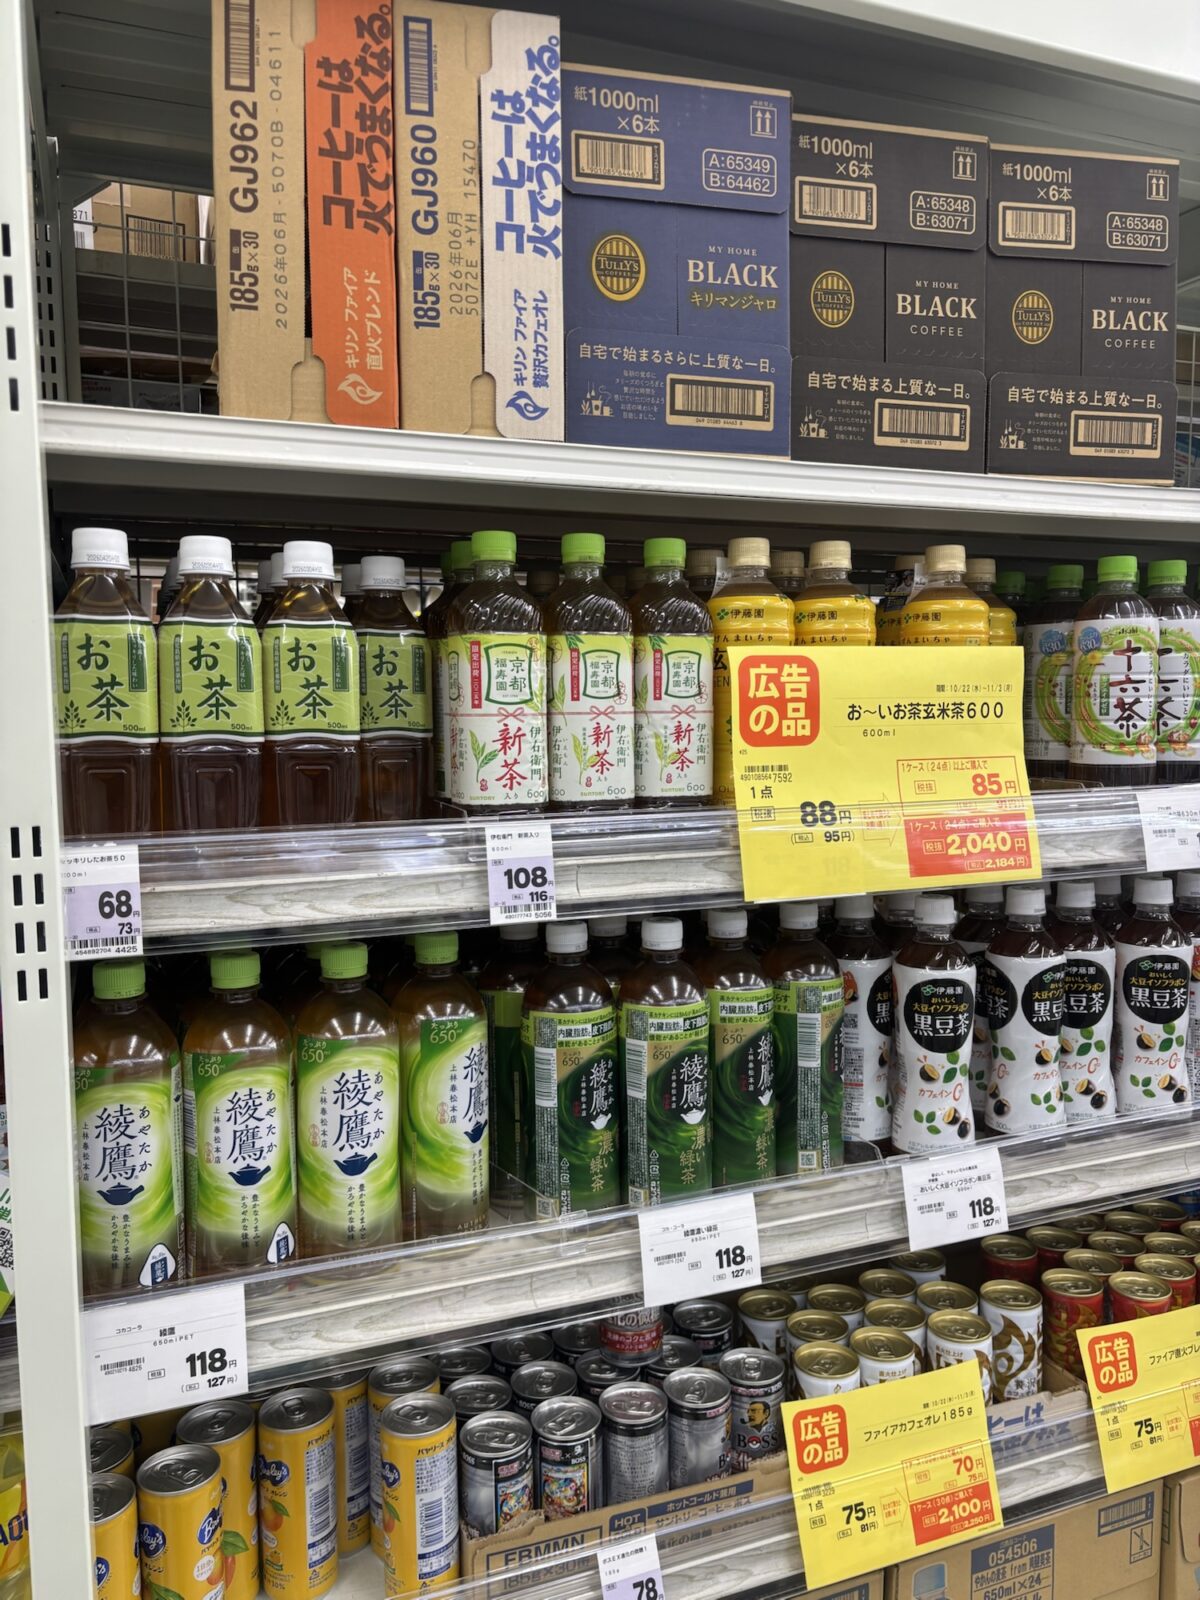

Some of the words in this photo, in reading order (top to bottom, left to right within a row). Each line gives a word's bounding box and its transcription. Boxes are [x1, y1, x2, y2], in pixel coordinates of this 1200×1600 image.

[355, 3, 393, 236] 火でうまくなる。
[617, 114, 659, 134] ×6本
[230, 100, 258, 213] GJ962
[316, 56, 355, 229] コーヒーは
[525, 35, 561, 259] 火でうまくなる。
[463, 140, 478, 200] 15470
[491, 89, 525, 254] コーヒーは
[709, 154, 770, 173] A:65349
[836, 160, 873, 178] ×6本
[411, 124, 440, 235] GJ960
[710, 174, 770, 192] B:64462
[1037, 185, 1072, 202] ×6本
[916, 196, 970, 212] A:65348
[916, 214, 968, 230] B:63071
[1112, 216, 1163, 231] A:65348
[708, 245, 723, 253] MY
[728, 247, 758, 257] HOME
[1112, 232, 1161, 247] B:63071
[448, 212, 464, 315] 2026年06月
[687, 259, 779, 288] BLACK
[344, 267, 358, 322] ファイア
[465, 258, 479, 316] 5072E
[916, 280, 928, 288] MY
[932, 281, 959, 289] HOME
[691, 291, 777, 311] キリマンジャロ
[896, 294, 977, 319] BLACK
[1126, 296, 1152, 304] HOME
[365, 270, 383, 371] 直火ブレンド
[514, 289, 528, 346] ファイア
[910, 324, 964, 337] COFFEE
[1091, 309, 1169, 332] BLACK
[345, 329, 359, 369] キリン
[532, 291, 549, 389] 贅沢カフェオレ
[1104, 338, 1156, 349] COFFEE
[513, 351, 527, 387] キリン
[580, 343, 776, 374] 自宅で始まるさらに上質な一日。
[808, 371, 970, 399] 自宅で始まる上質な一日。
[1008, 386, 1162, 409] 自宅で始まる上質な一日。
[730, 608, 764, 619] 伊藤園
[807, 611, 838, 621] 伊藤園
[912, 612, 941, 622] 伊藤園
[76, 633, 129, 721] お茶
[188, 635, 237, 721] お茶
[287, 636, 333, 720] お茶
[372, 644, 413, 719] お茶
[494, 657, 507, 691] 福寿園
[508, 657, 526, 693] 京都
[600, 660, 614, 689] 京都
[682, 660, 695, 689] 京都
[748, 664, 811, 699] 広告
[1108, 639, 1147, 738] 十六茶
[749, 702, 811, 737] の品
[862, 728, 896, 738] 600ml
[492, 723, 528, 790] 新茶
[530, 726, 542, 781] 伊右衛門
[552, 726, 562, 778] 伊右衛門
[588, 722, 614, 775] 新茶
[616, 724, 627, 767] 伊右衛門
[669, 721, 694, 772] 新茶
[696, 723, 707, 765] 伊右衛門
[527, 788, 544, 798] 600
[607, 786, 626, 795] 600
[687, 783, 705, 792] 600
[917, 782, 934, 791] 税抜
[946, 832, 1027, 856] 2,040円
[1154, 961, 1180, 970] 伊藤園
[936, 986, 963, 995] 伊藤園
[1129, 976, 1187, 986] 大豆イソフラボン
[1130, 987, 1187, 1009] 黒豆茶
[913, 1012, 970, 1037] 黒豆茶
[450, 1063, 458, 1124] 上林春松本店
[463, 1043, 485, 1122] 綾鷹
[589, 1059, 608, 1115] 綾鷹
[679, 1054, 704, 1109] 綾鷹
[319, 1086, 328, 1149] 上林春松本店
[332, 1069, 374, 1153] 綾鷹
[372, 1071, 385, 1141] あやたか
[213, 1106, 221, 1164] 上林春松本店
[225, 1088, 265, 1163] 綾鷹
[265, 1089, 278, 1154] あやたか
[95, 1104, 137, 1182] 綾鷹
[138, 1106, 152, 1174] あやたか
[115, 1325, 142, 1334] コカコーラ
[1094, 1337, 1130, 1364] 広告
[1014, 1378, 1036, 1390] 贅沢
[1100, 1359, 1134, 1385] の品
[800, 1411, 841, 1442] 広告
[864, 1406, 973, 1442] ファイアカフェオレ185g
[1134, 1418, 1162, 1438] 75円
[803, 1437, 844, 1465] の品
[953, 1456, 984, 1475] 70円
[667, 1486, 736, 1512] ホットコールド兼用
[842, 1502, 876, 1525] 75円
[938, 1498, 991, 1524] 2,100円
[614, 1513, 640, 1528] HOT
[988, 1538, 1038, 1567] 054506
